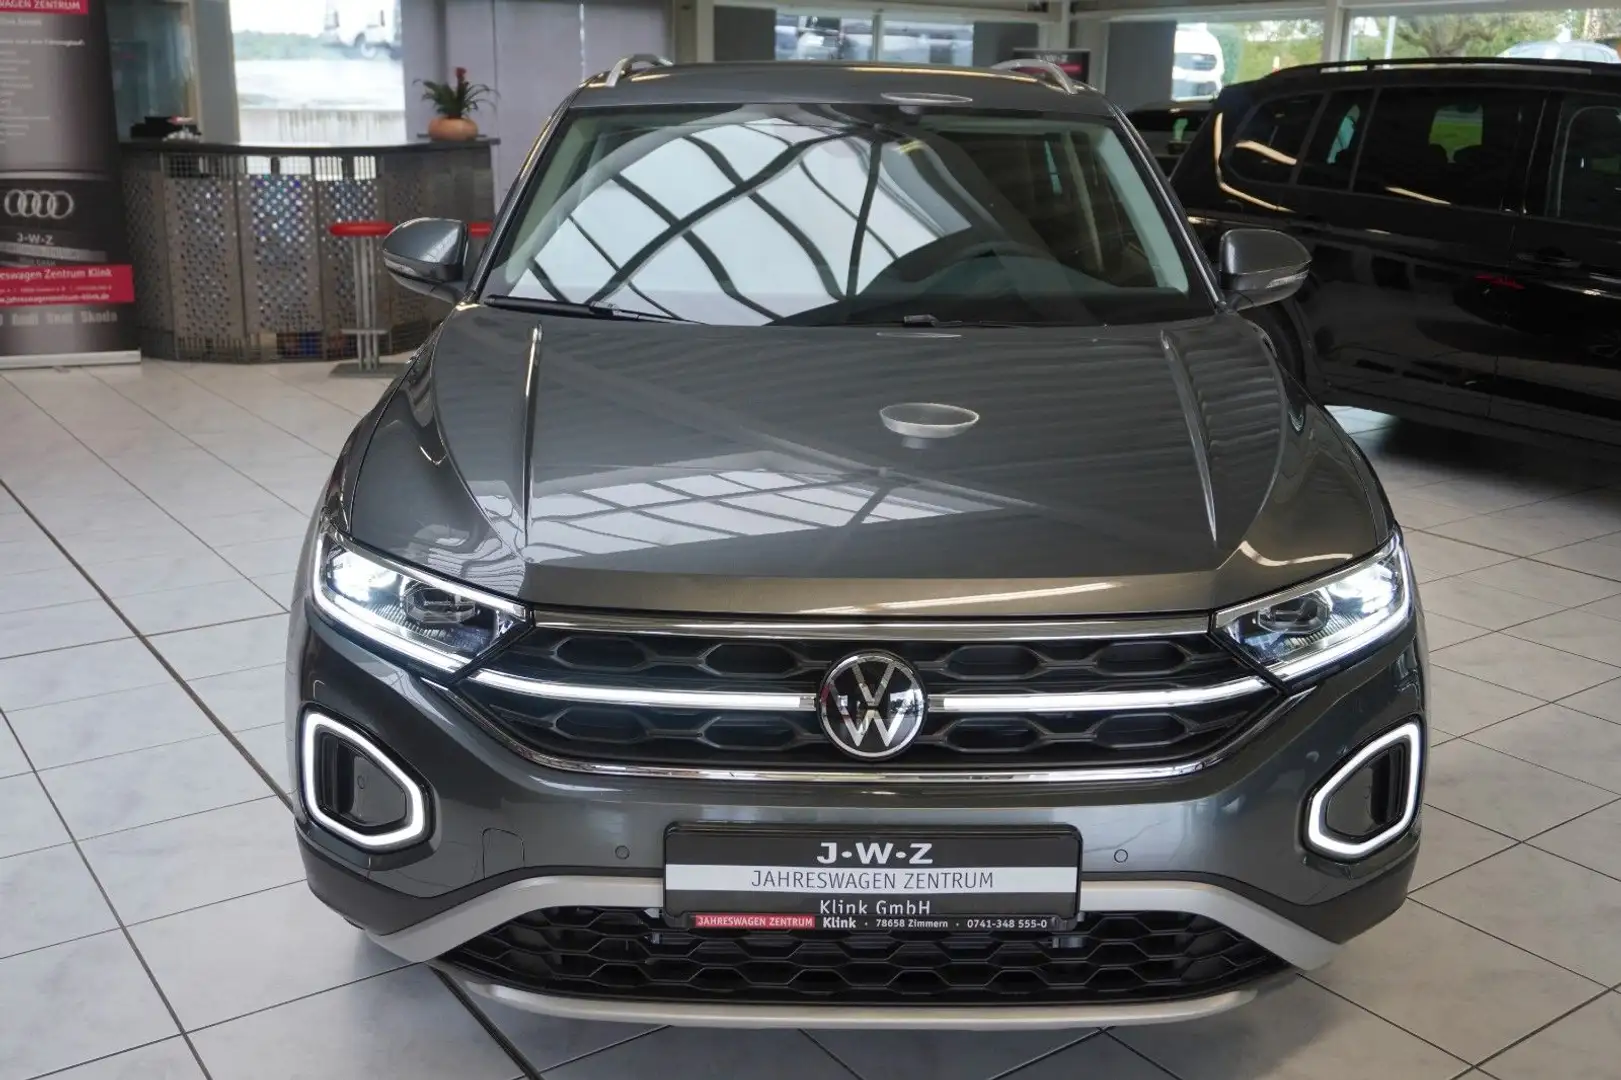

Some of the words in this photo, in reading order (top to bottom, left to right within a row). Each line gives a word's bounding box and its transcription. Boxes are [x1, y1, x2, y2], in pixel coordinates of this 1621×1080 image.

[34, 0, 80, 10] ZENTRUM
[44, 268, 86, 279] Zentrum
[88, 267, 113, 277] Klink
[751, 870, 896, 889] JAHRESWAGEN
[903, 872, 994, 889] ZENTRUM
[820, 900, 868, 915] Klink
[875, 900, 931, 915] GmbH
[697, 916, 766, 926] JAHRESWAGEN
[769, 917, 813, 927] ZENTRUM
[822, 917, 857, 928] Klink
[876, 918, 905, 927] 78658
[907, 918, 949, 928] Zimmern
[966, 919, 1015, 928] 0741-348
[1018, 919, 1048, 929] 555-0
